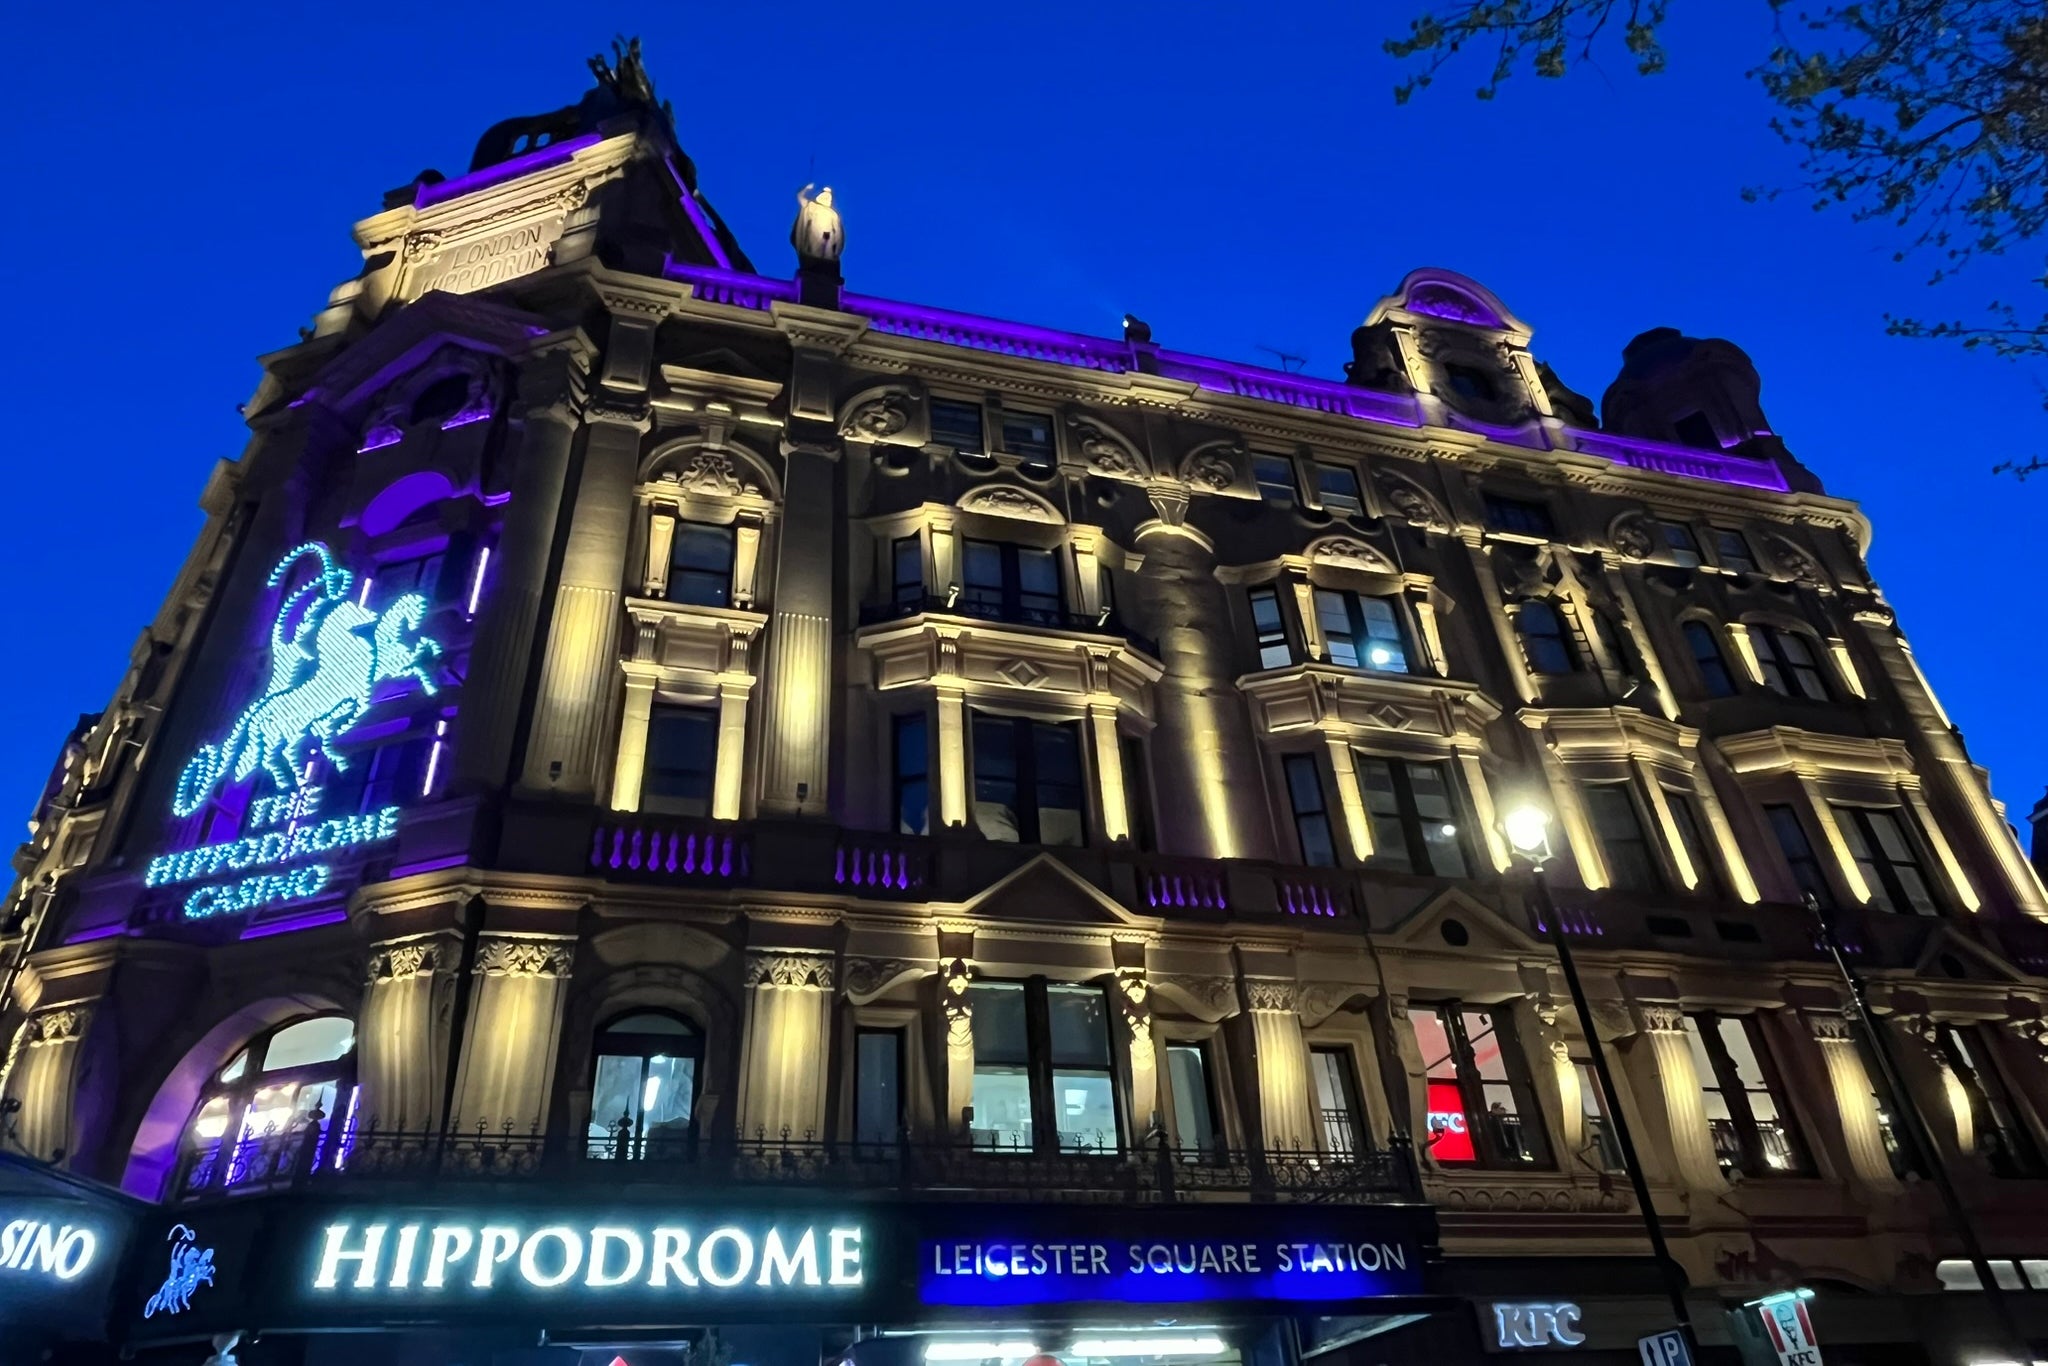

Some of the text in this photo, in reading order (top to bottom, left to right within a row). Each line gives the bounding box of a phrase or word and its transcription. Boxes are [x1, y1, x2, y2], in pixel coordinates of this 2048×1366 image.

[453, 225, 542, 268] LONDON
[251, 788, 320, 827] THE
[146, 807, 399, 887] HIPPODROME
[184, 864, 329, 919] CASINO
[313, 1225, 865, 1290] HIPPODROME
[935, 1243, 1407, 1276] LEICESTER SQUARE STATION
[1492, 1302, 1586, 1347] KFC
[1664, 1337, 1681, 1362] P
[1787, 1350, 1817, 1366] KFC
